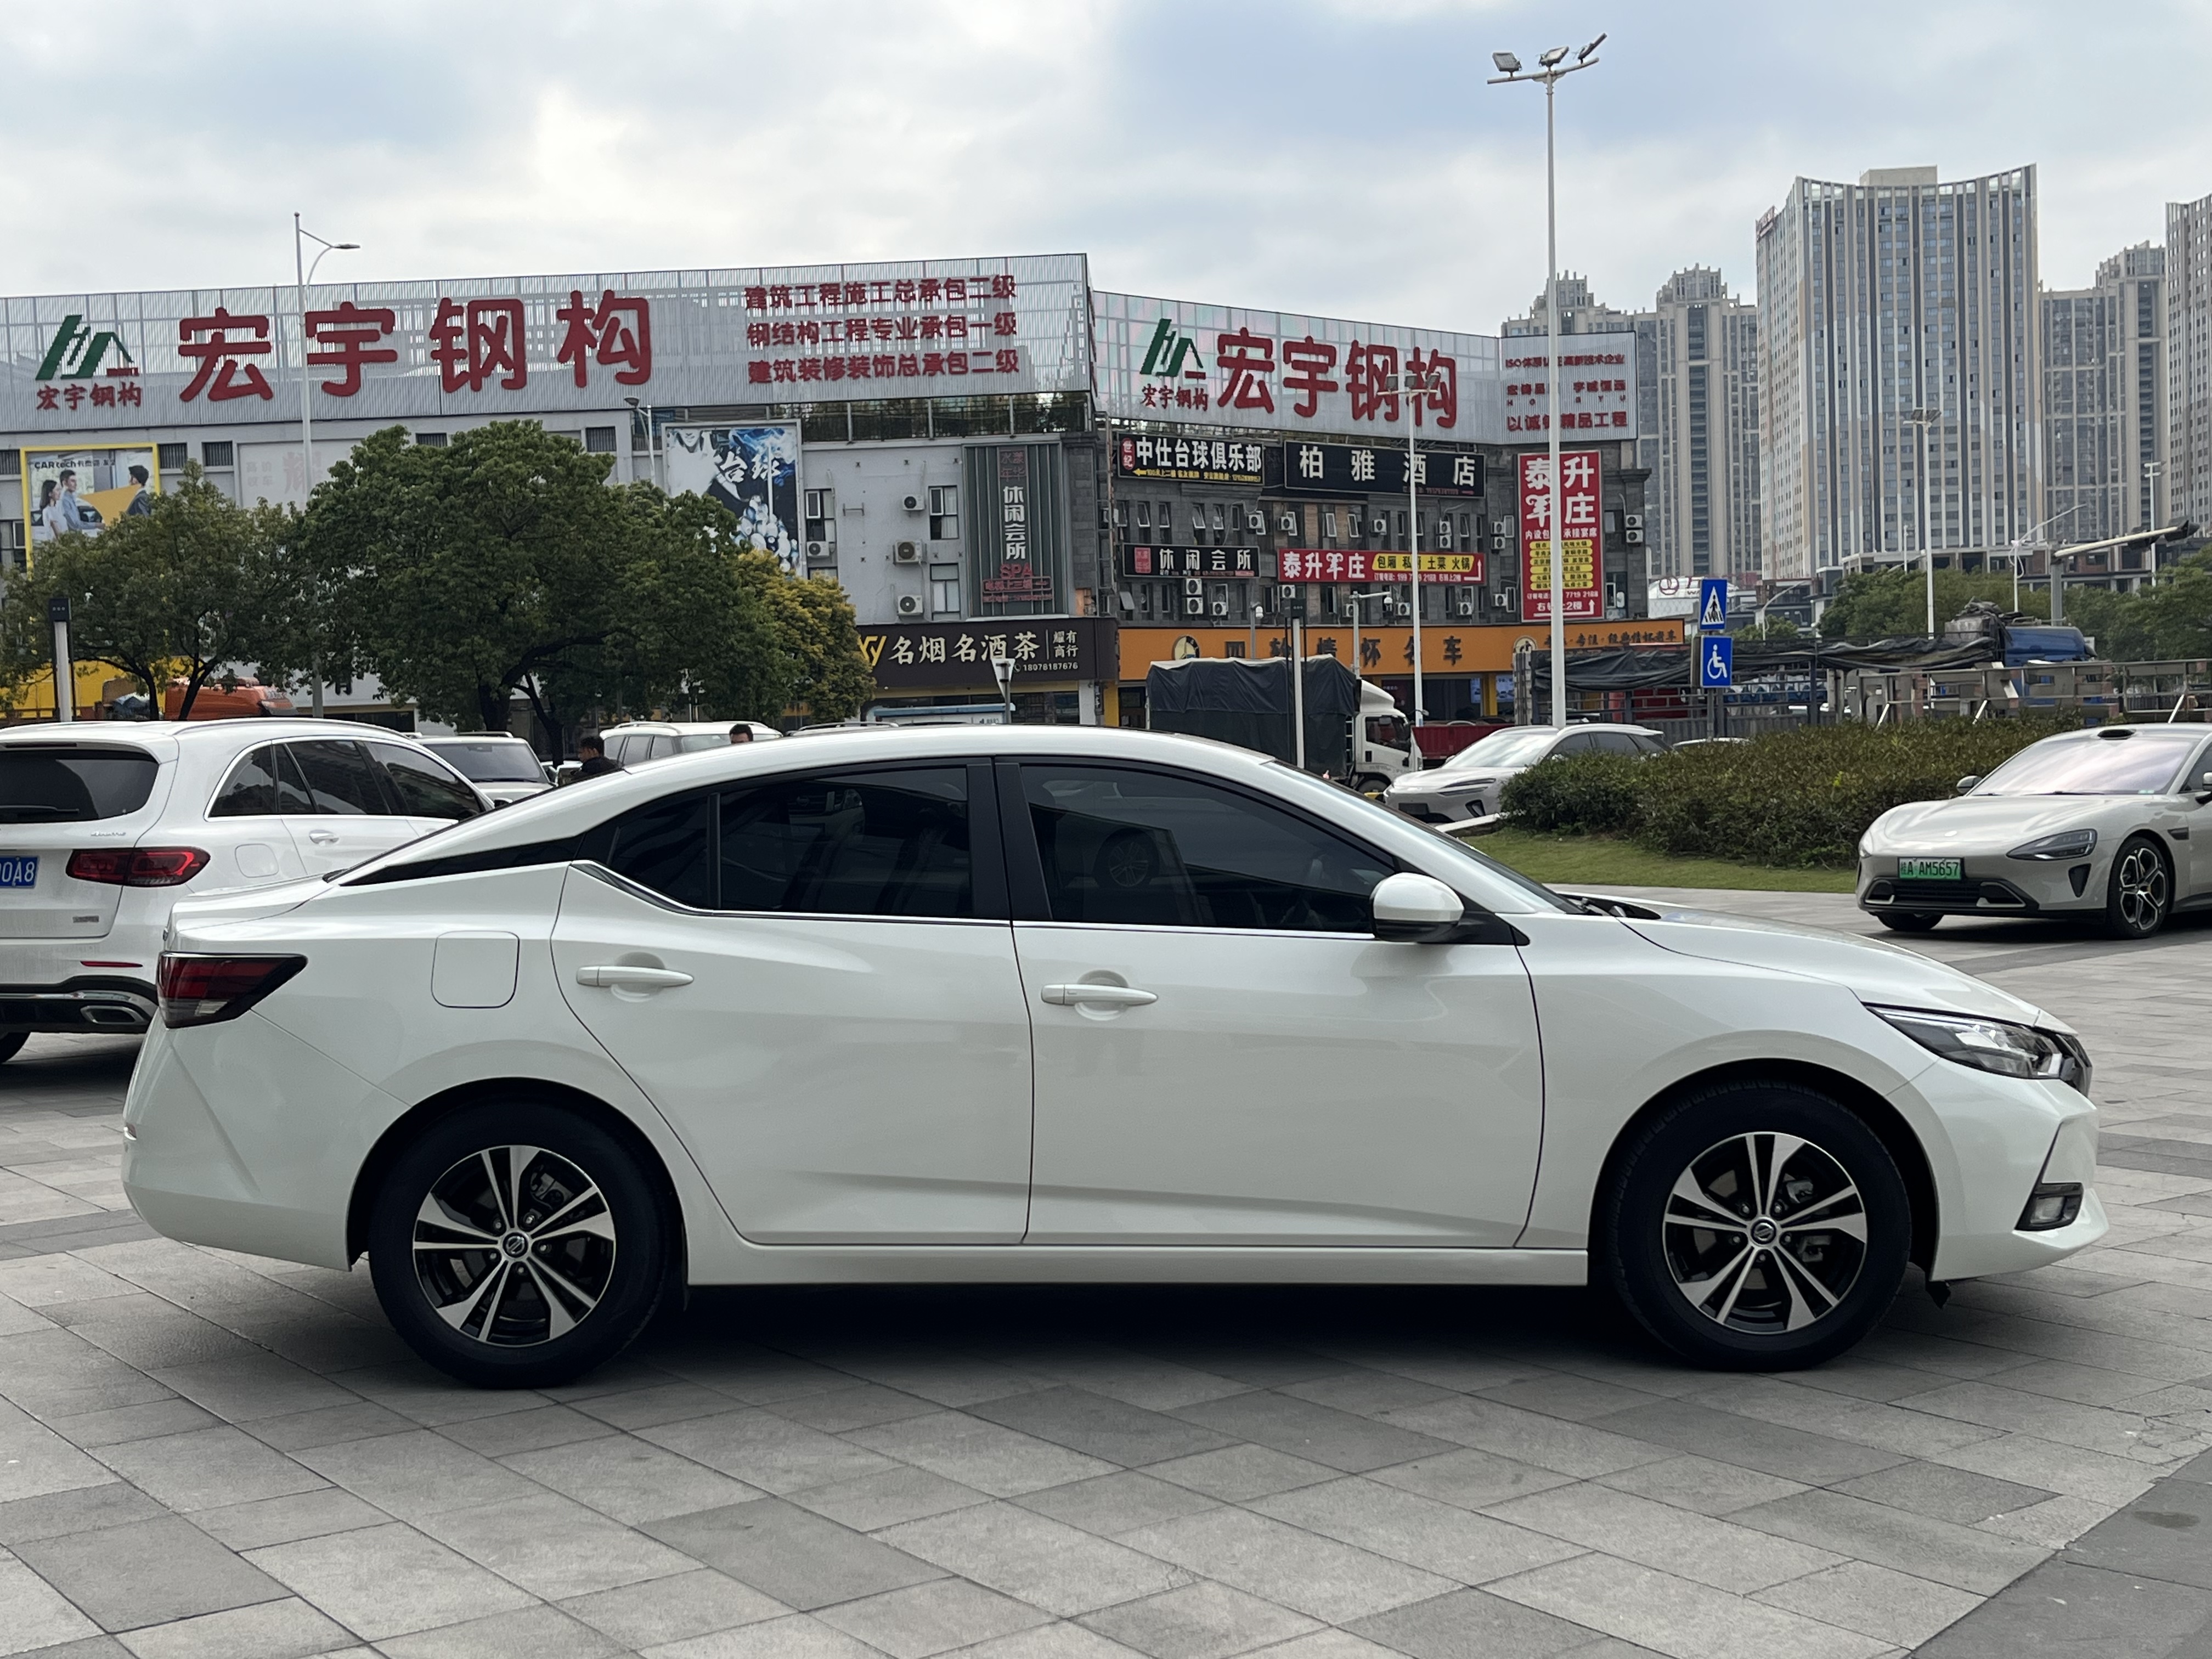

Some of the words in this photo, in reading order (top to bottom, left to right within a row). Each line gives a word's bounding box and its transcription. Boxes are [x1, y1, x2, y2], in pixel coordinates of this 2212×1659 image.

[744, 274, 1017, 310] 建筑工程施工总承包二级
[178, 290, 651, 401] 宏宇钢构
[747, 312, 1018, 347] 钢结构工程专业承包一级
[748, 349, 1019, 384] 建筑装修装饰总承包二级
[1217, 327, 1457, 428] 宏宇钢构
[36, 382, 142, 411] 宏宇钢构
[1141, 383, 1209, 411] 宏宇钢构
[720, 451, 781, 483] 台球
[1136, 437, 1262, 472] 中仕台球俱乐部
[1300, 445, 1476, 487] 柏雅酒店
[1525, 456, 1595, 489] 泰升
[1003, 486, 1026, 560] 休闲会所
[1000, 563, 1033, 579] SPA
[1160, 548, 1251, 571] 休闲会所
[1283, 551, 1365, 580] 泰升羊庄
[1427, 556, 1446, 569] 土菜
[1452, 557, 1470, 570] 火锅
[889, 631, 1040, 665] 名烟名酒茶
[1053, 644, 1079, 658] 商行
[0, 861, 35, 883] 0A8
[1919, 861, 1959, 876] AM5657
